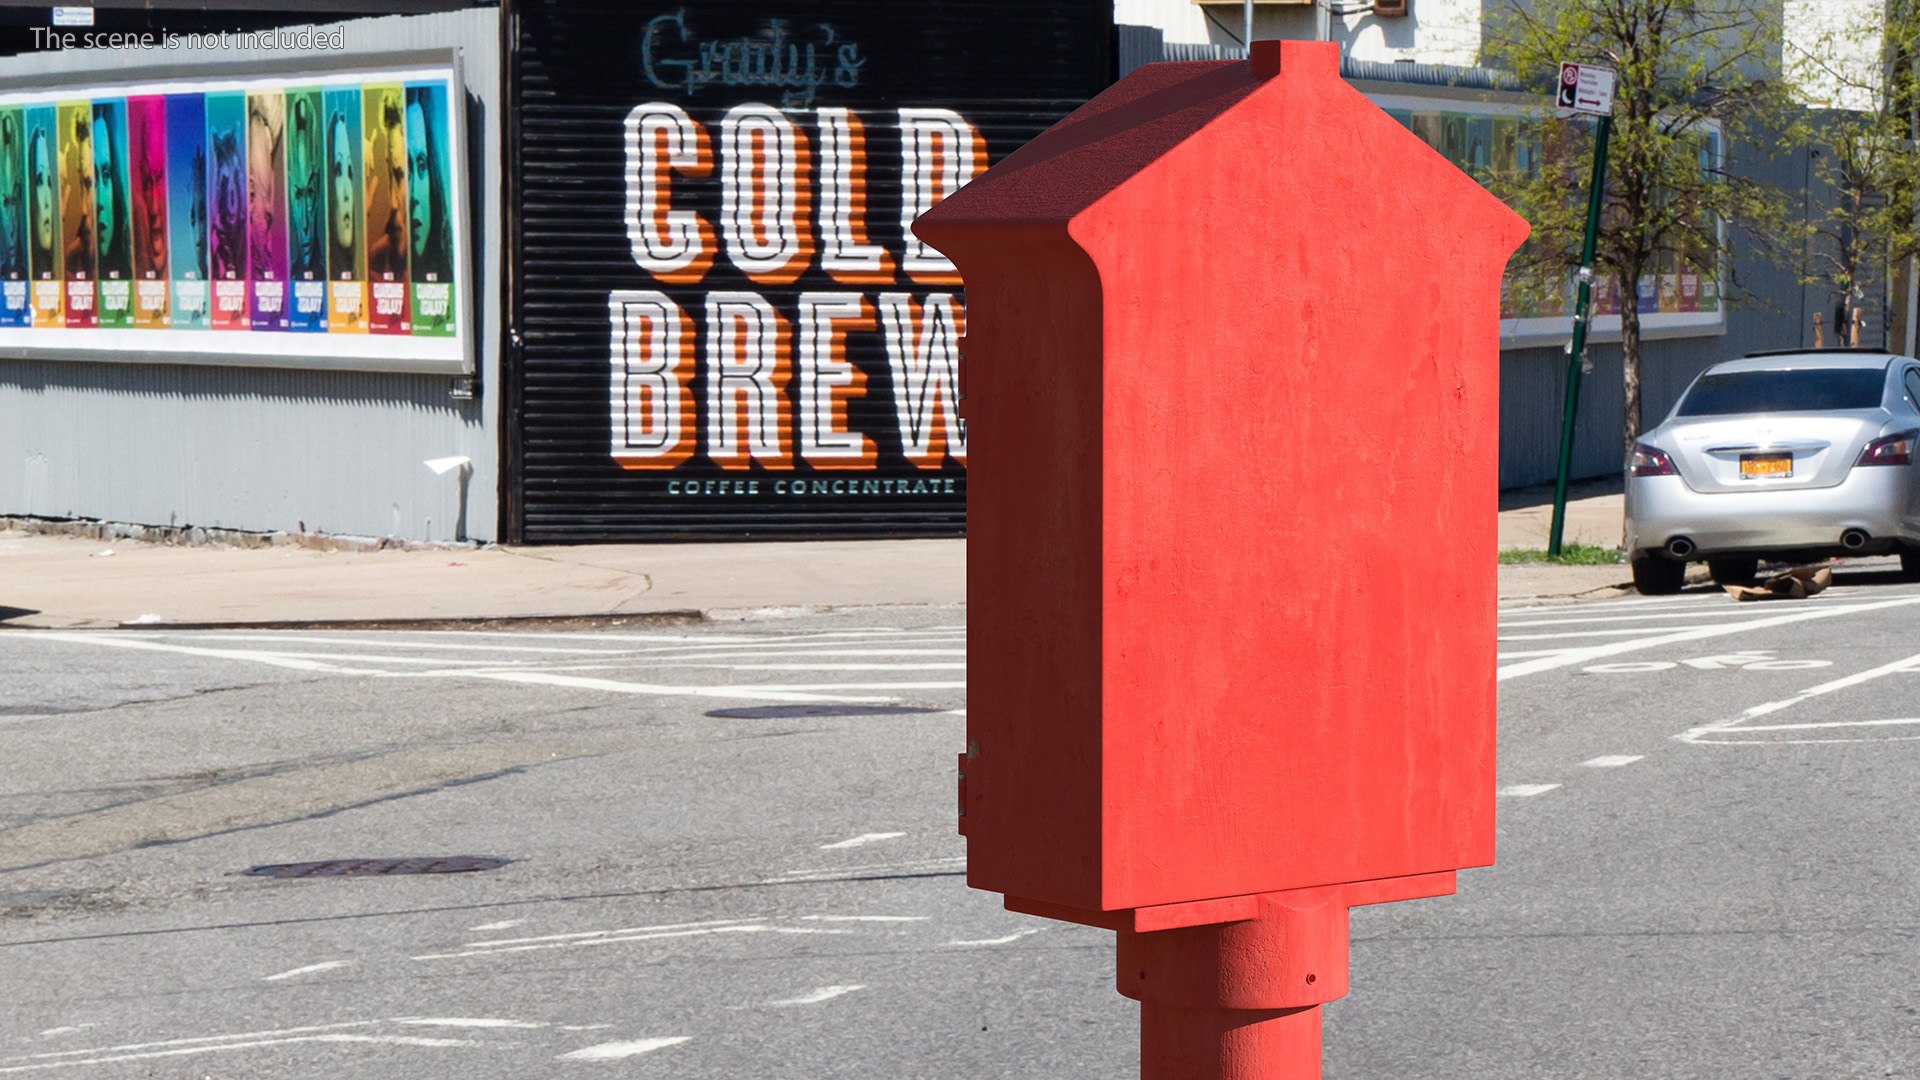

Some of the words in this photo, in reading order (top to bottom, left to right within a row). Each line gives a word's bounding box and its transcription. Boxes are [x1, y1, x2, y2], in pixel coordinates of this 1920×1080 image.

[642, 8, 866, 111] Grady's
[623, 102, 989, 285] COLD
[608, 290, 967, 470] BREW
[667, 481, 760, 495] COFFEE
[774, 479, 956, 495] CONCENTRATE
